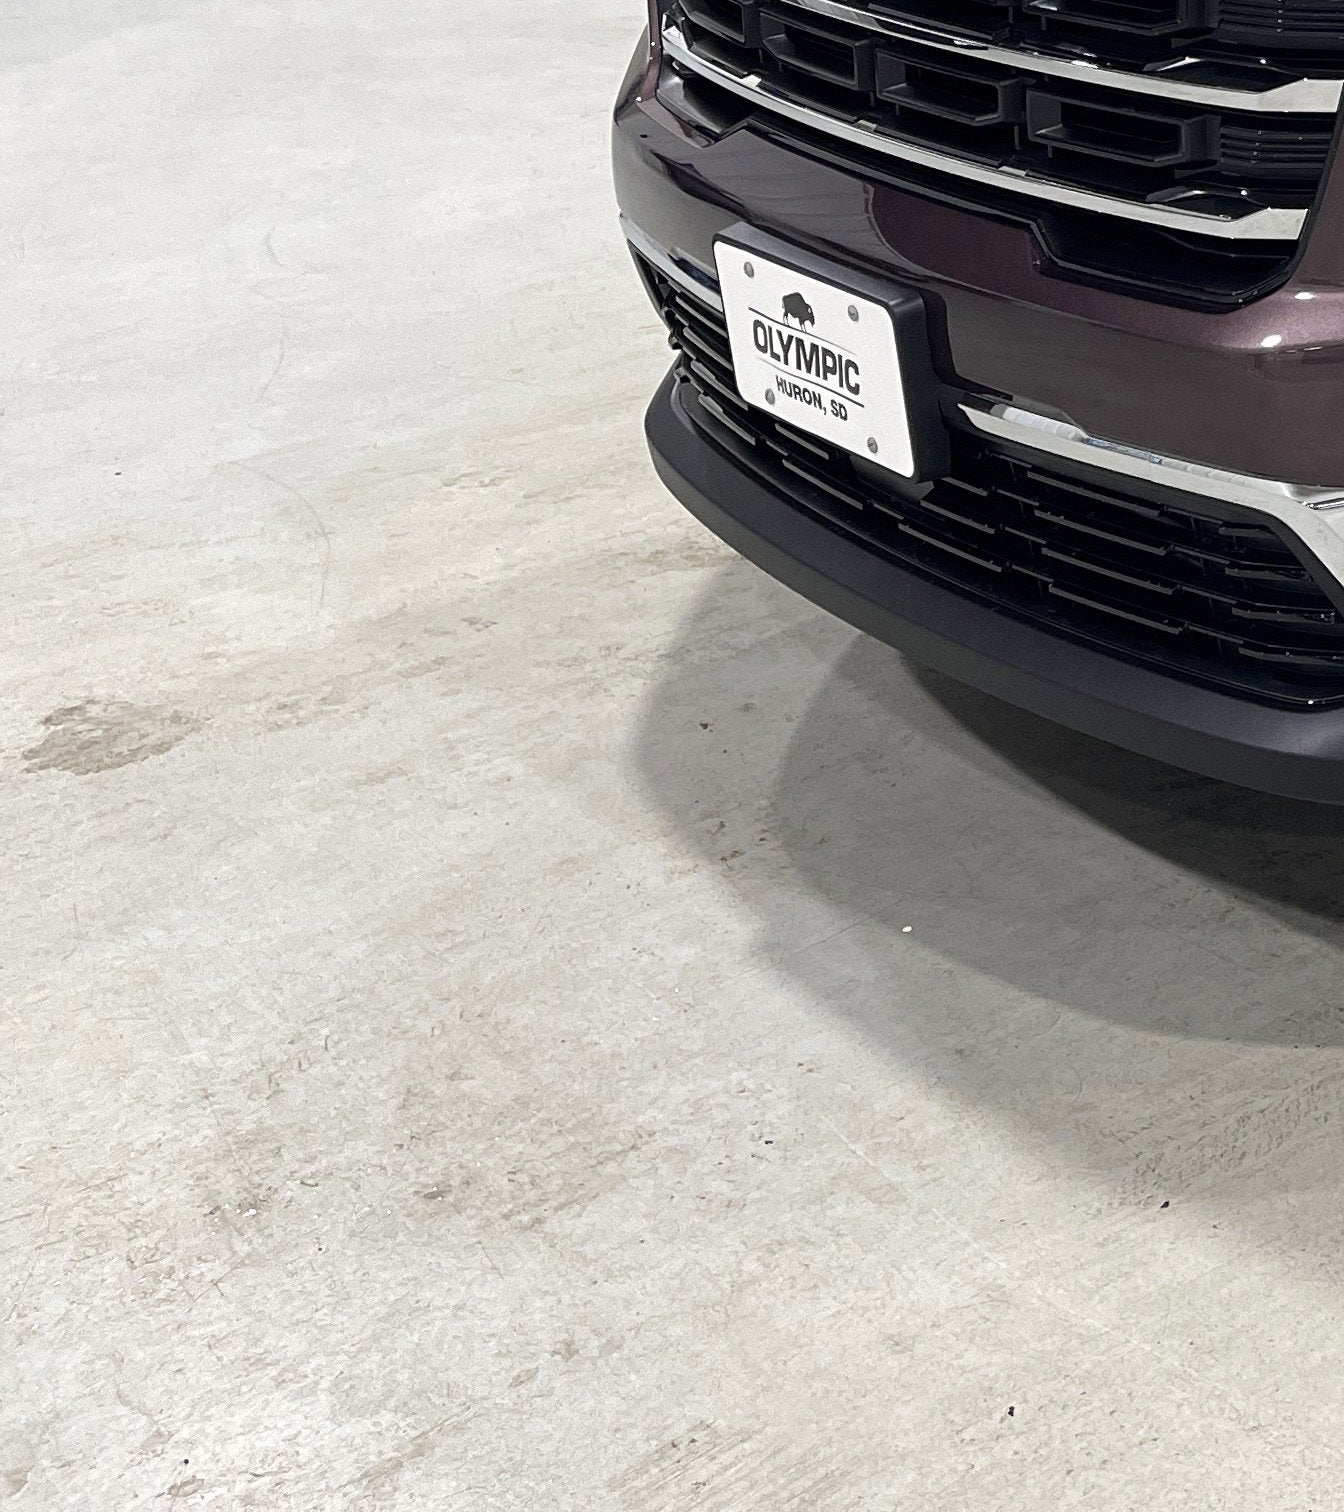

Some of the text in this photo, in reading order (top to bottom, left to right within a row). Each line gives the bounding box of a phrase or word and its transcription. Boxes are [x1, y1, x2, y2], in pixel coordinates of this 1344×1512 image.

[752, 318, 861, 396] OLYMPIC
[775, 374, 849, 422] HURON, SD
